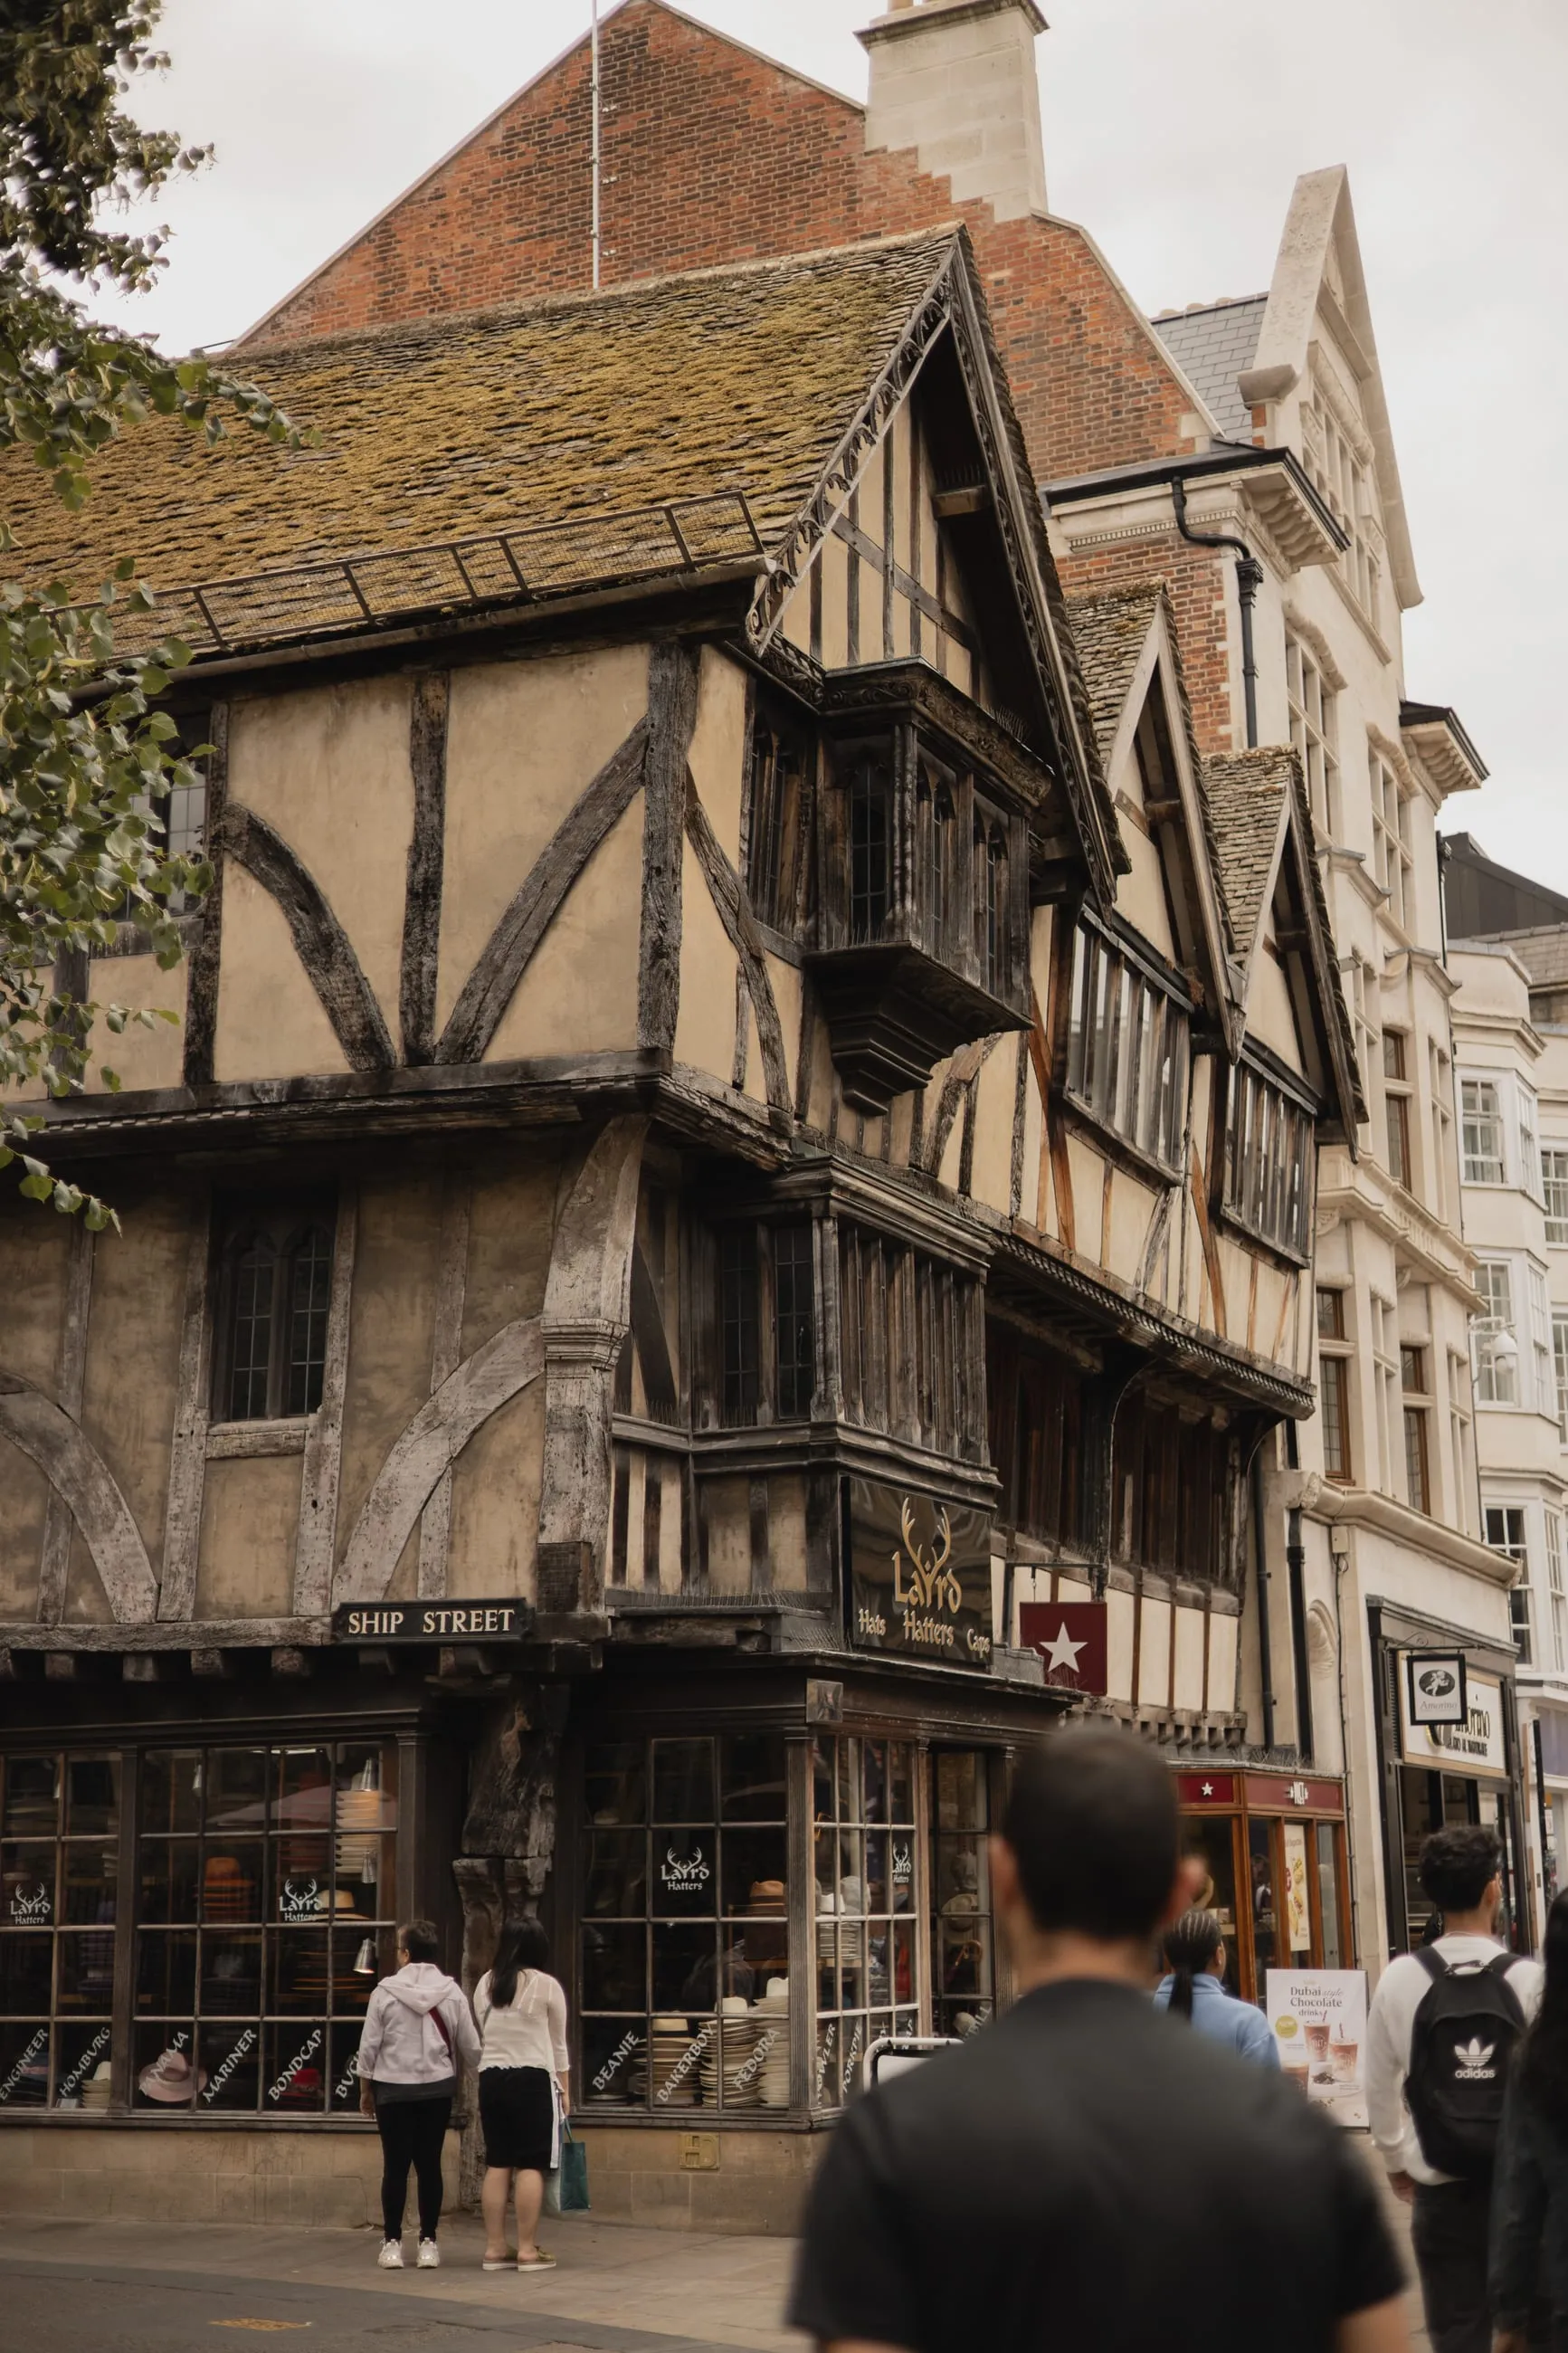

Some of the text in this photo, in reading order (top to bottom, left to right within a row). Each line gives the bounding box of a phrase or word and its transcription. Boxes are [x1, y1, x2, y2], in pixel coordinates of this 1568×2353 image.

[891, 1550, 963, 1615] Laird
[348, 1608, 515, 1634] SHIP STREET
[859, 1607, 887, 1636] Hats
[903, 1608, 955, 1647] Hatters
[966, 1628, 991, 1659] Caps
[667, 1881, 703, 1891] Hatters
[14, 1915, 45, 1925] Hatters
[1290, 1986, 1321, 1996] Dubai
[1290, 1996, 1343, 2007] Chocolate
[0, 2028, 49, 2101] ENGINEER
[202, 2028, 258, 2103] MARINER
[268, 2028, 322, 2101] BONDCAP
[335, 2051, 359, 2099] BUC
[592, 2030, 640, 2091] BEANIE
[734, 2027, 781, 2090] FEDORA
[1455, 2067, 1495, 2079] adidas
